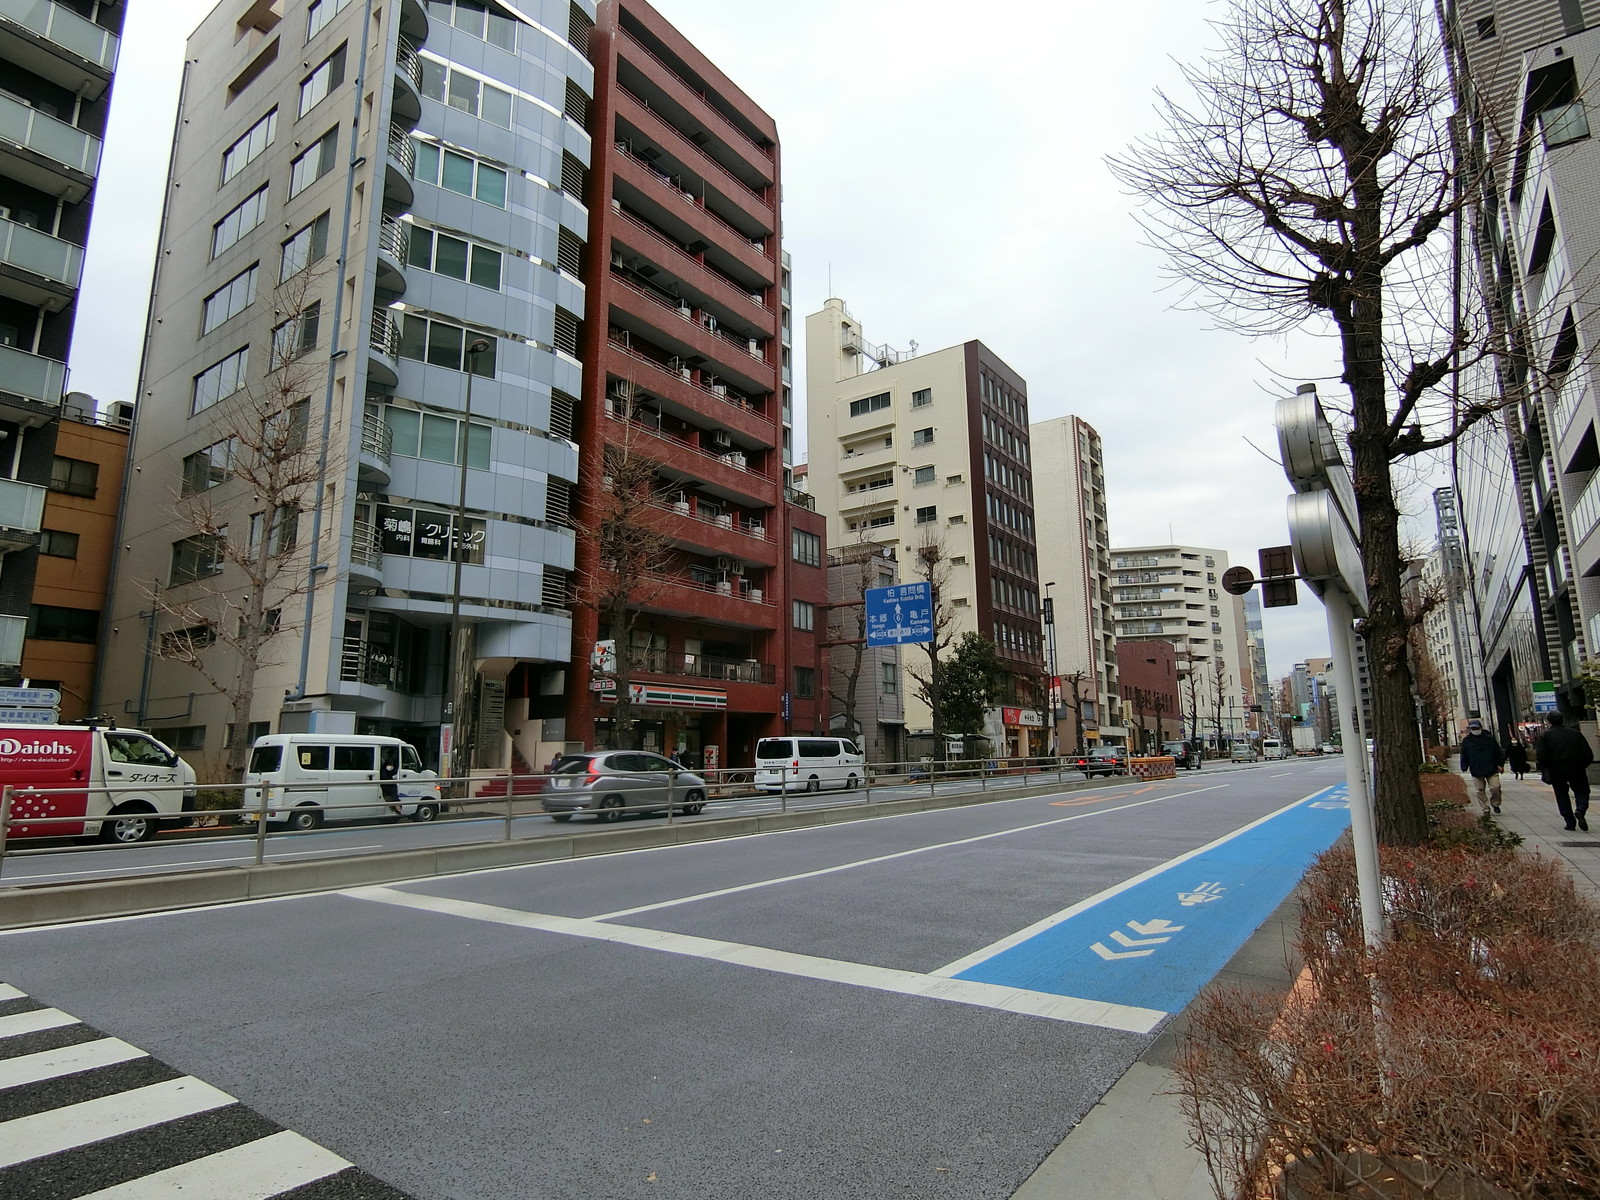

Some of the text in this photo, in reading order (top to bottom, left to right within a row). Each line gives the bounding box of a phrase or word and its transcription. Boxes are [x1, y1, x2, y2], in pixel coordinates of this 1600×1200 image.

[395, 534, 411, 542] 内科
[425, 523, 486, 543] クリニック
[910, 608, 928, 618] 亀戸
[0, 738, 73, 756] Daiohs
[129, 773, 178, 782] ダイオーズ
